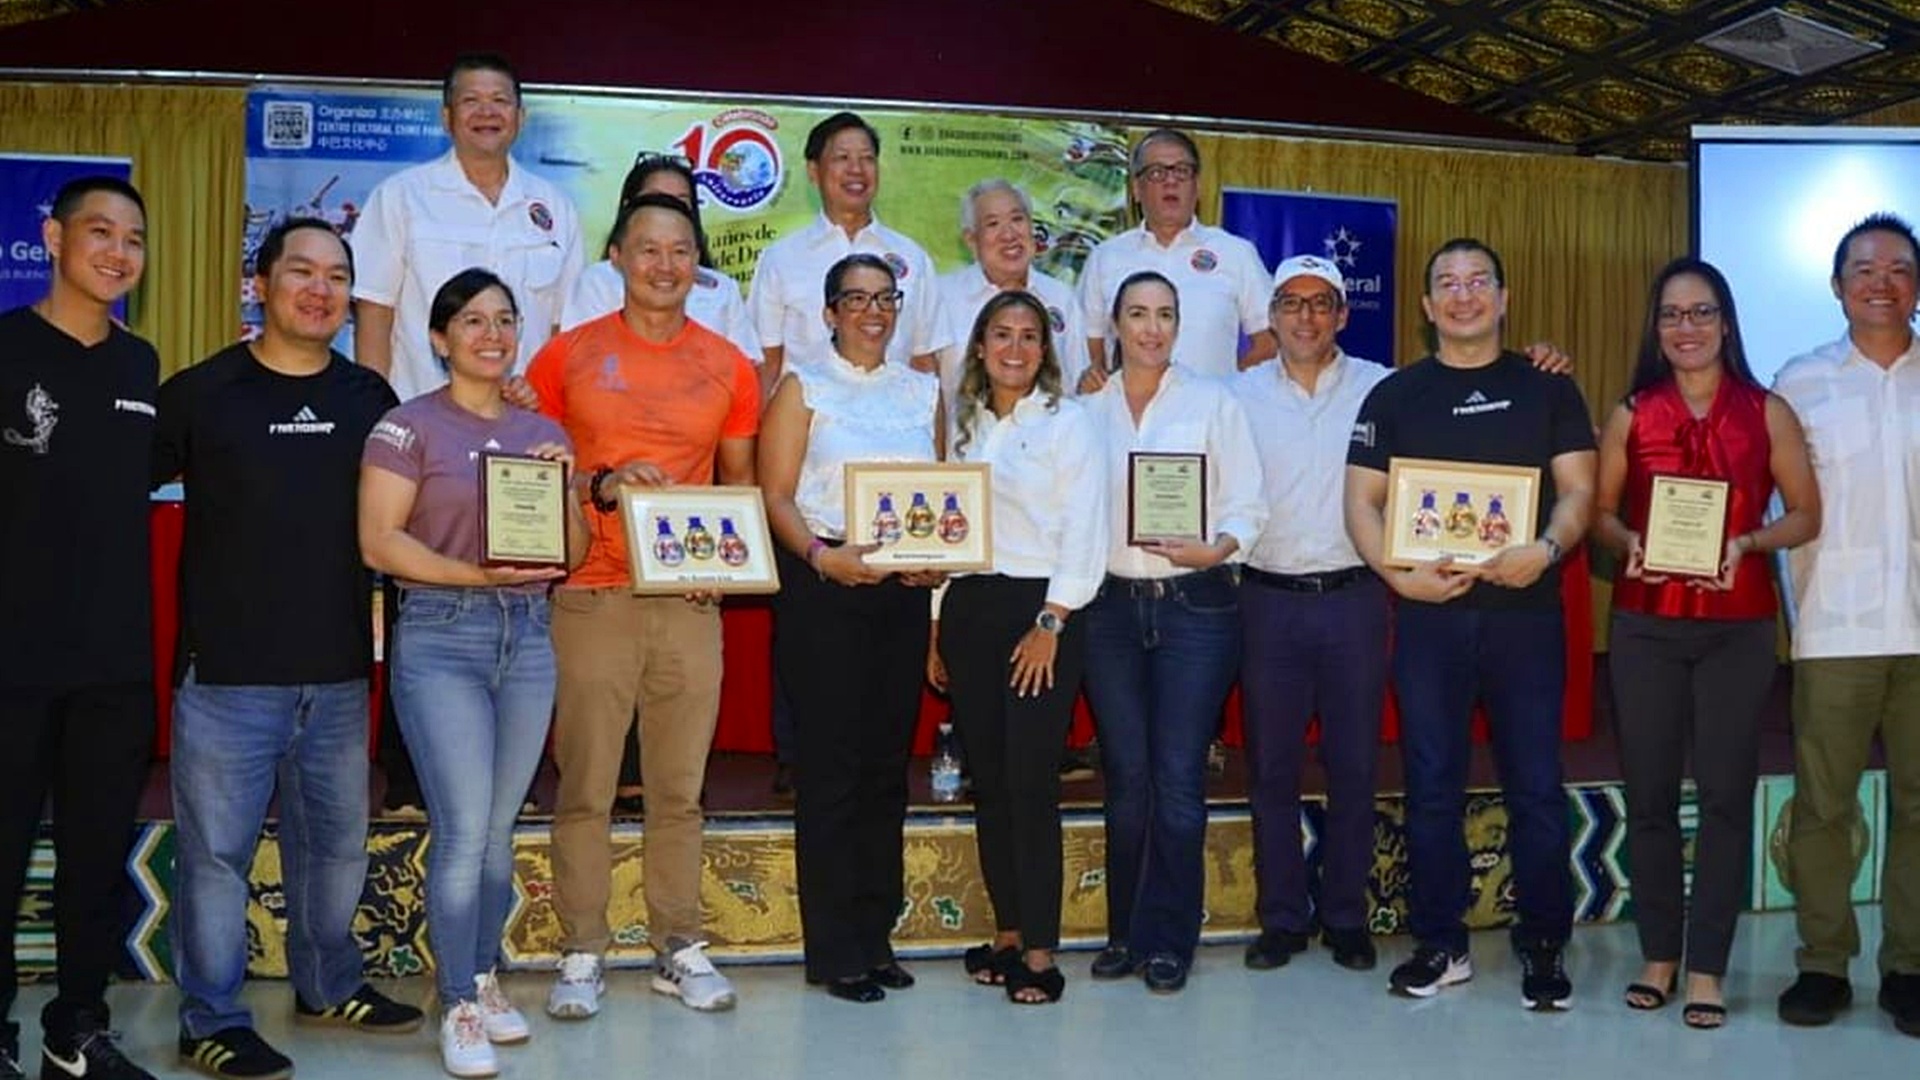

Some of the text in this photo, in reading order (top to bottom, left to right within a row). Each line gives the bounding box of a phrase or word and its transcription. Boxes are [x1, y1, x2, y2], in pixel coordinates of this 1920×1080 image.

[317, 122, 350, 133] CENTRO
[352, 123, 392, 134] CULTURAL
[755, 223, 777, 240] de
